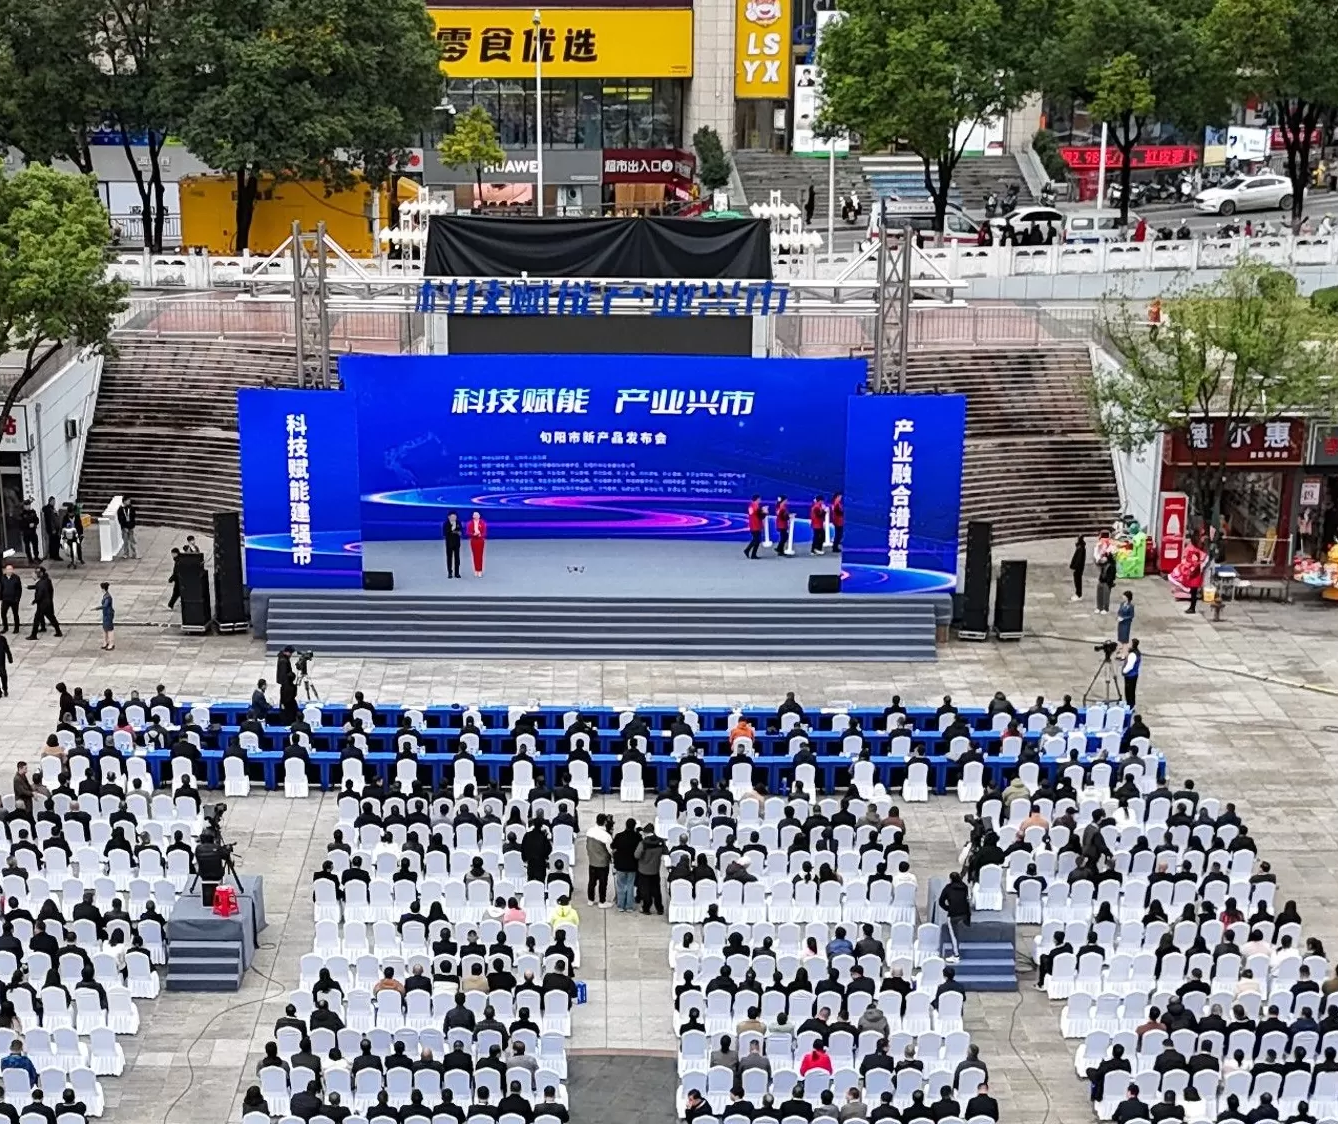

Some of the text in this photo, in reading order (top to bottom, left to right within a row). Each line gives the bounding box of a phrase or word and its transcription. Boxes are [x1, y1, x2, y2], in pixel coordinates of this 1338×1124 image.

[436, 27, 598, 63] 零食优选
[747, 32, 782, 56] LS
[743, 60, 781, 83] YX
[484, 160, 539, 174] HUAWE
[605, 159, 661, 173] 超市出入口
[451, 387, 755, 416] 科技赋能 产业兴市
[539, 430, 668, 446] 旬阳市新产品发布会
[286, 413, 312, 565] 科技赋能建强市
[887, 418, 915, 569] 产业融合谱新篇
